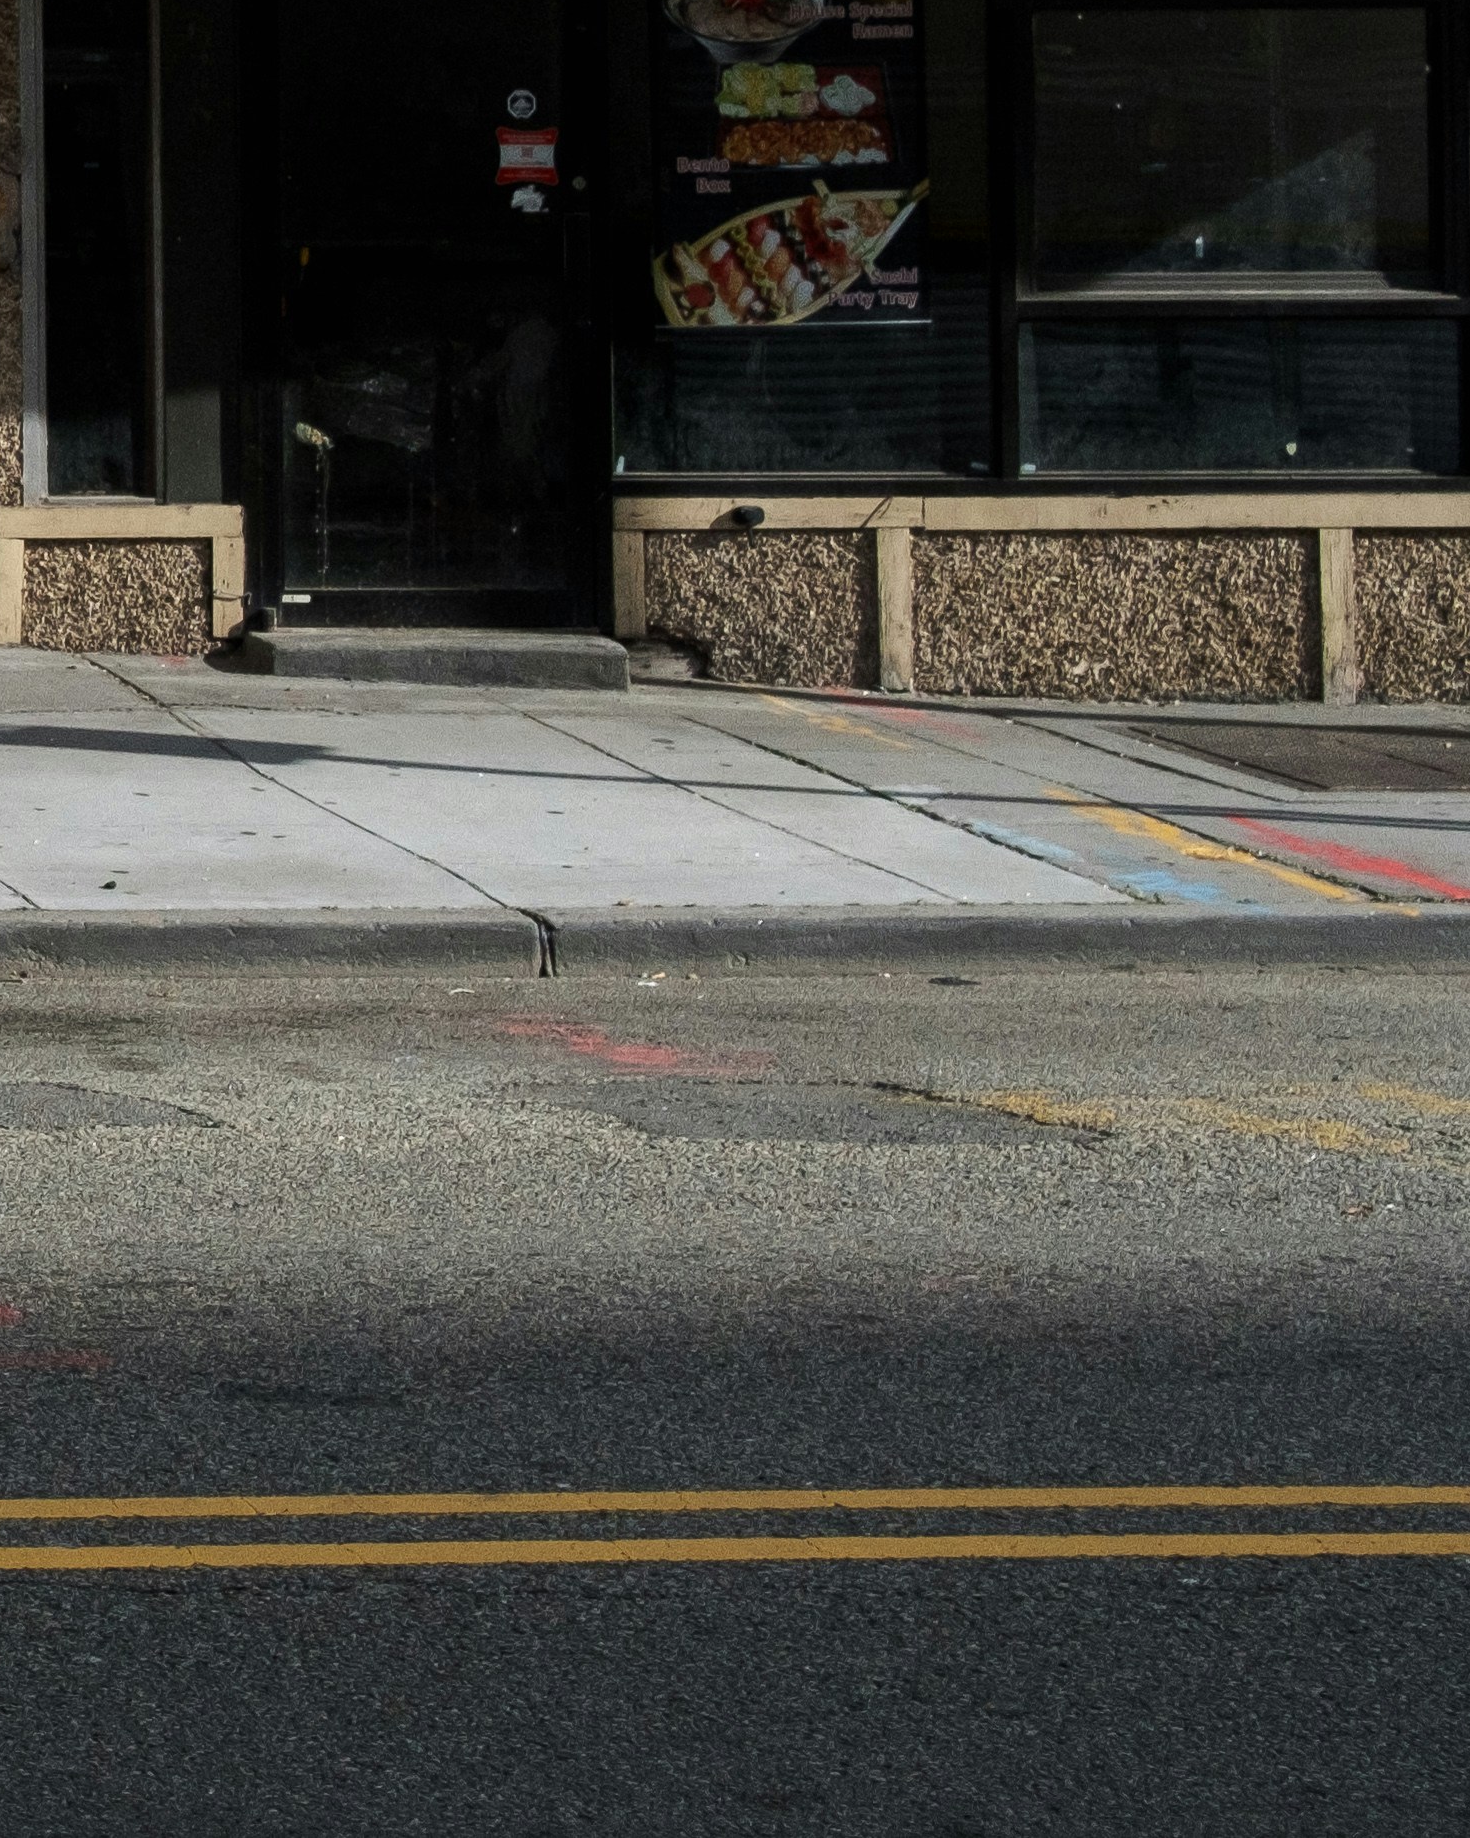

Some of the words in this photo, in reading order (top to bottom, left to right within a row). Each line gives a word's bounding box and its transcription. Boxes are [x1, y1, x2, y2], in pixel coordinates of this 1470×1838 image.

[789, 2, 845, 19] House
[848, 0, 914, 22] Special
[852, 22, 914, 39] Ramen
[676, 156, 730, 173] Bento
[696, 177, 731, 193] Box
[870, 266, 918, 284] Sushi
[828, 290, 874, 310] Party
[878, 288, 919, 309] Tray
